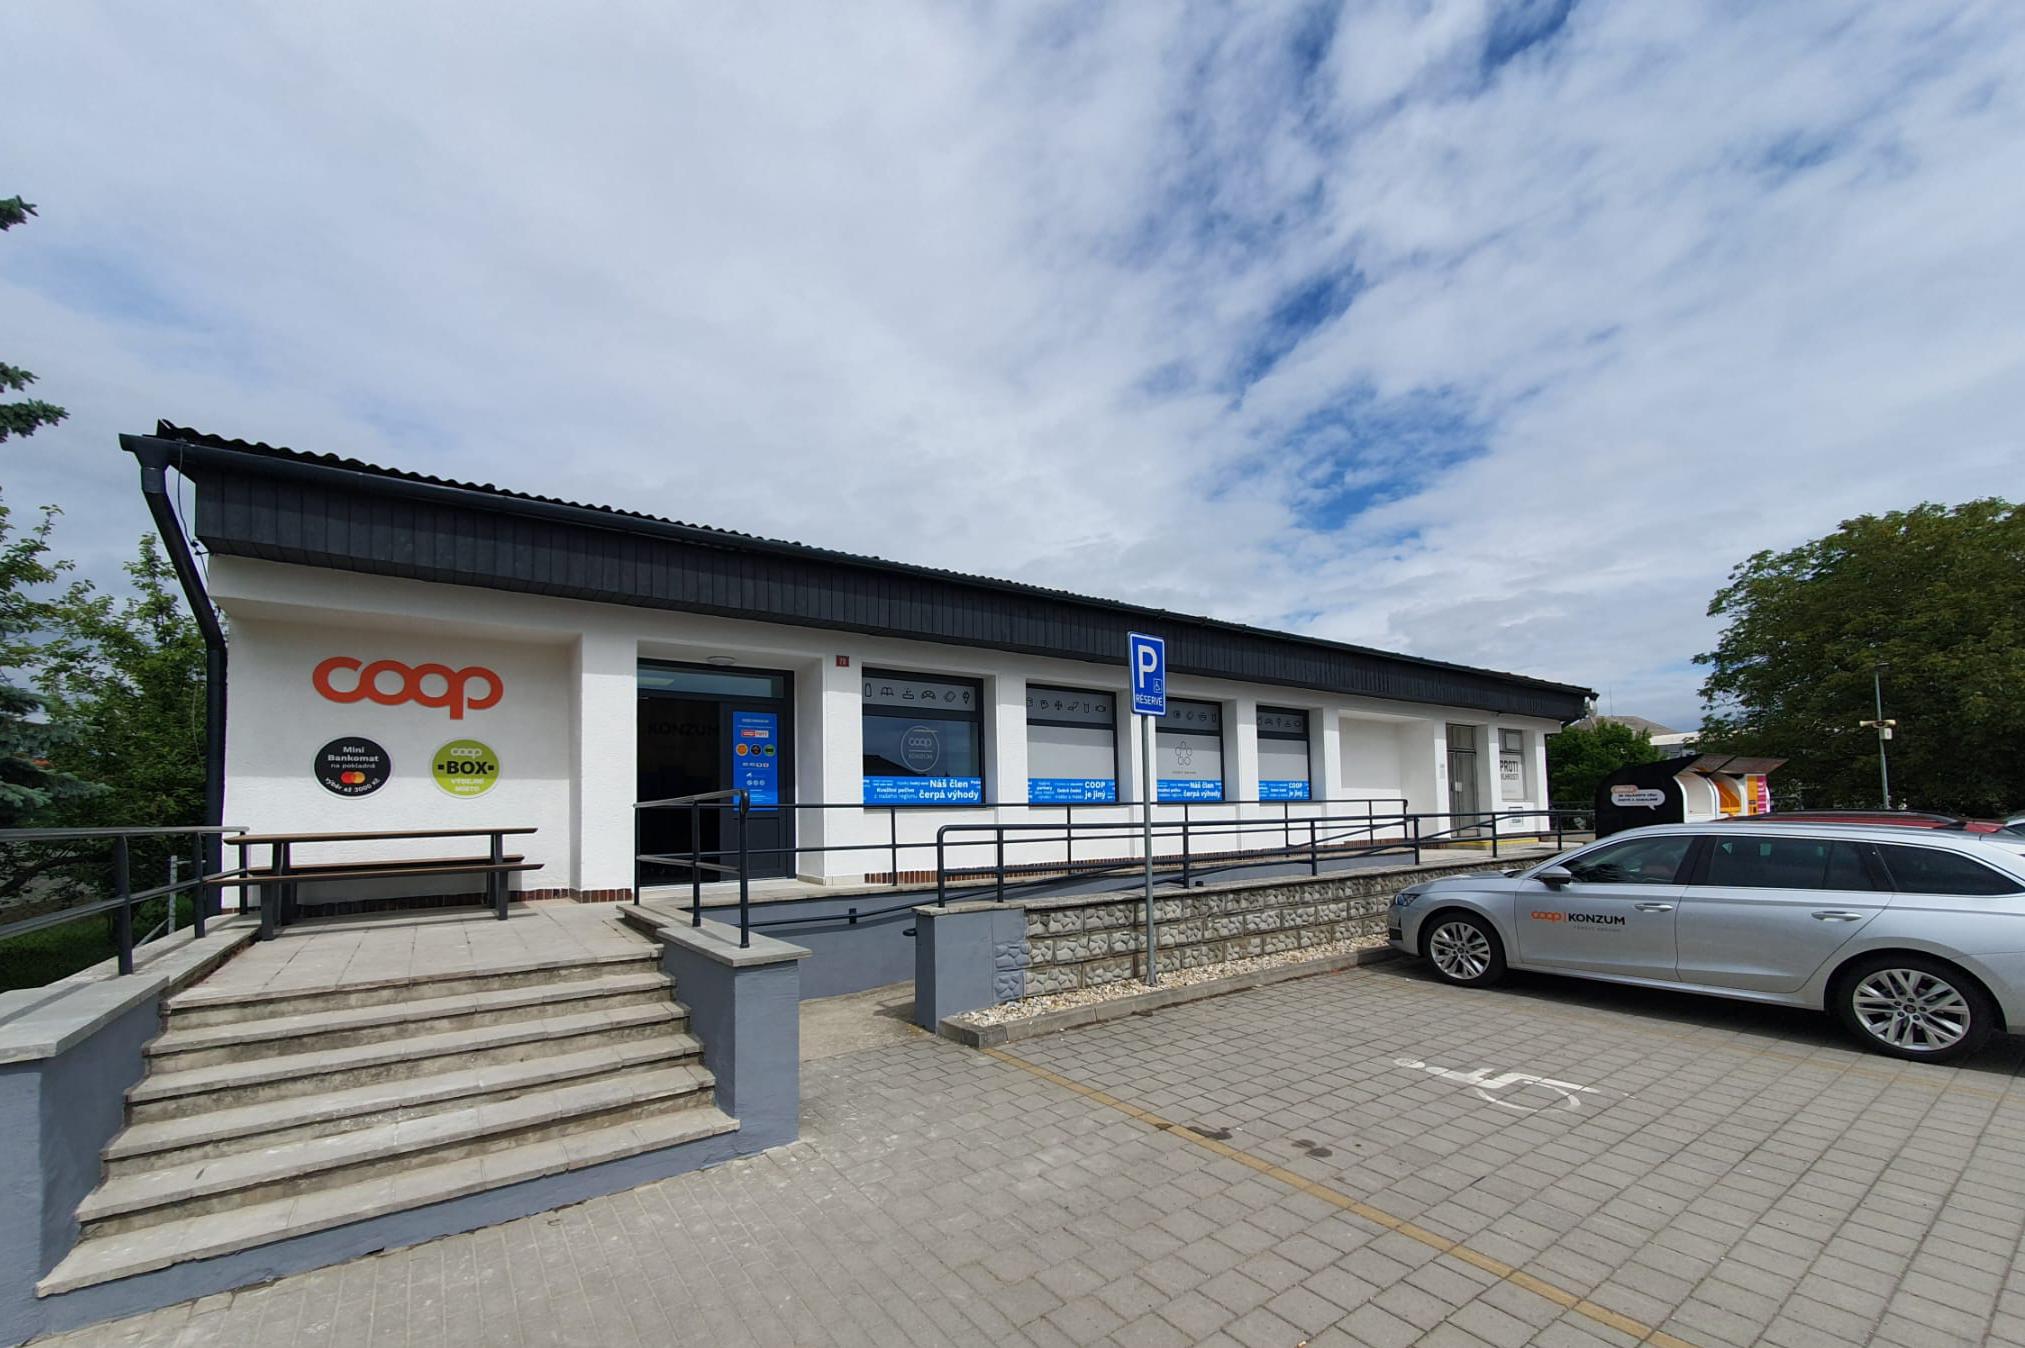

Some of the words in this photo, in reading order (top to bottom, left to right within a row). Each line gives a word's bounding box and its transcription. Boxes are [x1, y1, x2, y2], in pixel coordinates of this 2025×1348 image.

[1138, 645, 1158, 688] P
[312, 656, 504, 720] coop
[327, 754, 379, 762] Bankomat
[446, 761, 488, 775] BOX
[1500, 760, 1519, 772] PROTI
[930, 779, 947, 788] Náš
[949, 779, 969, 788] člen
[1084, 781, 1106, 789] COOP
[919, 789, 945, 801] čerpá
[947, 789, 979, 801] výhody
[1084, 790, 1092, 800] je
[1531, 911, 1562, 924] coop
[1568, 913, 1625, 925] KONZUM
